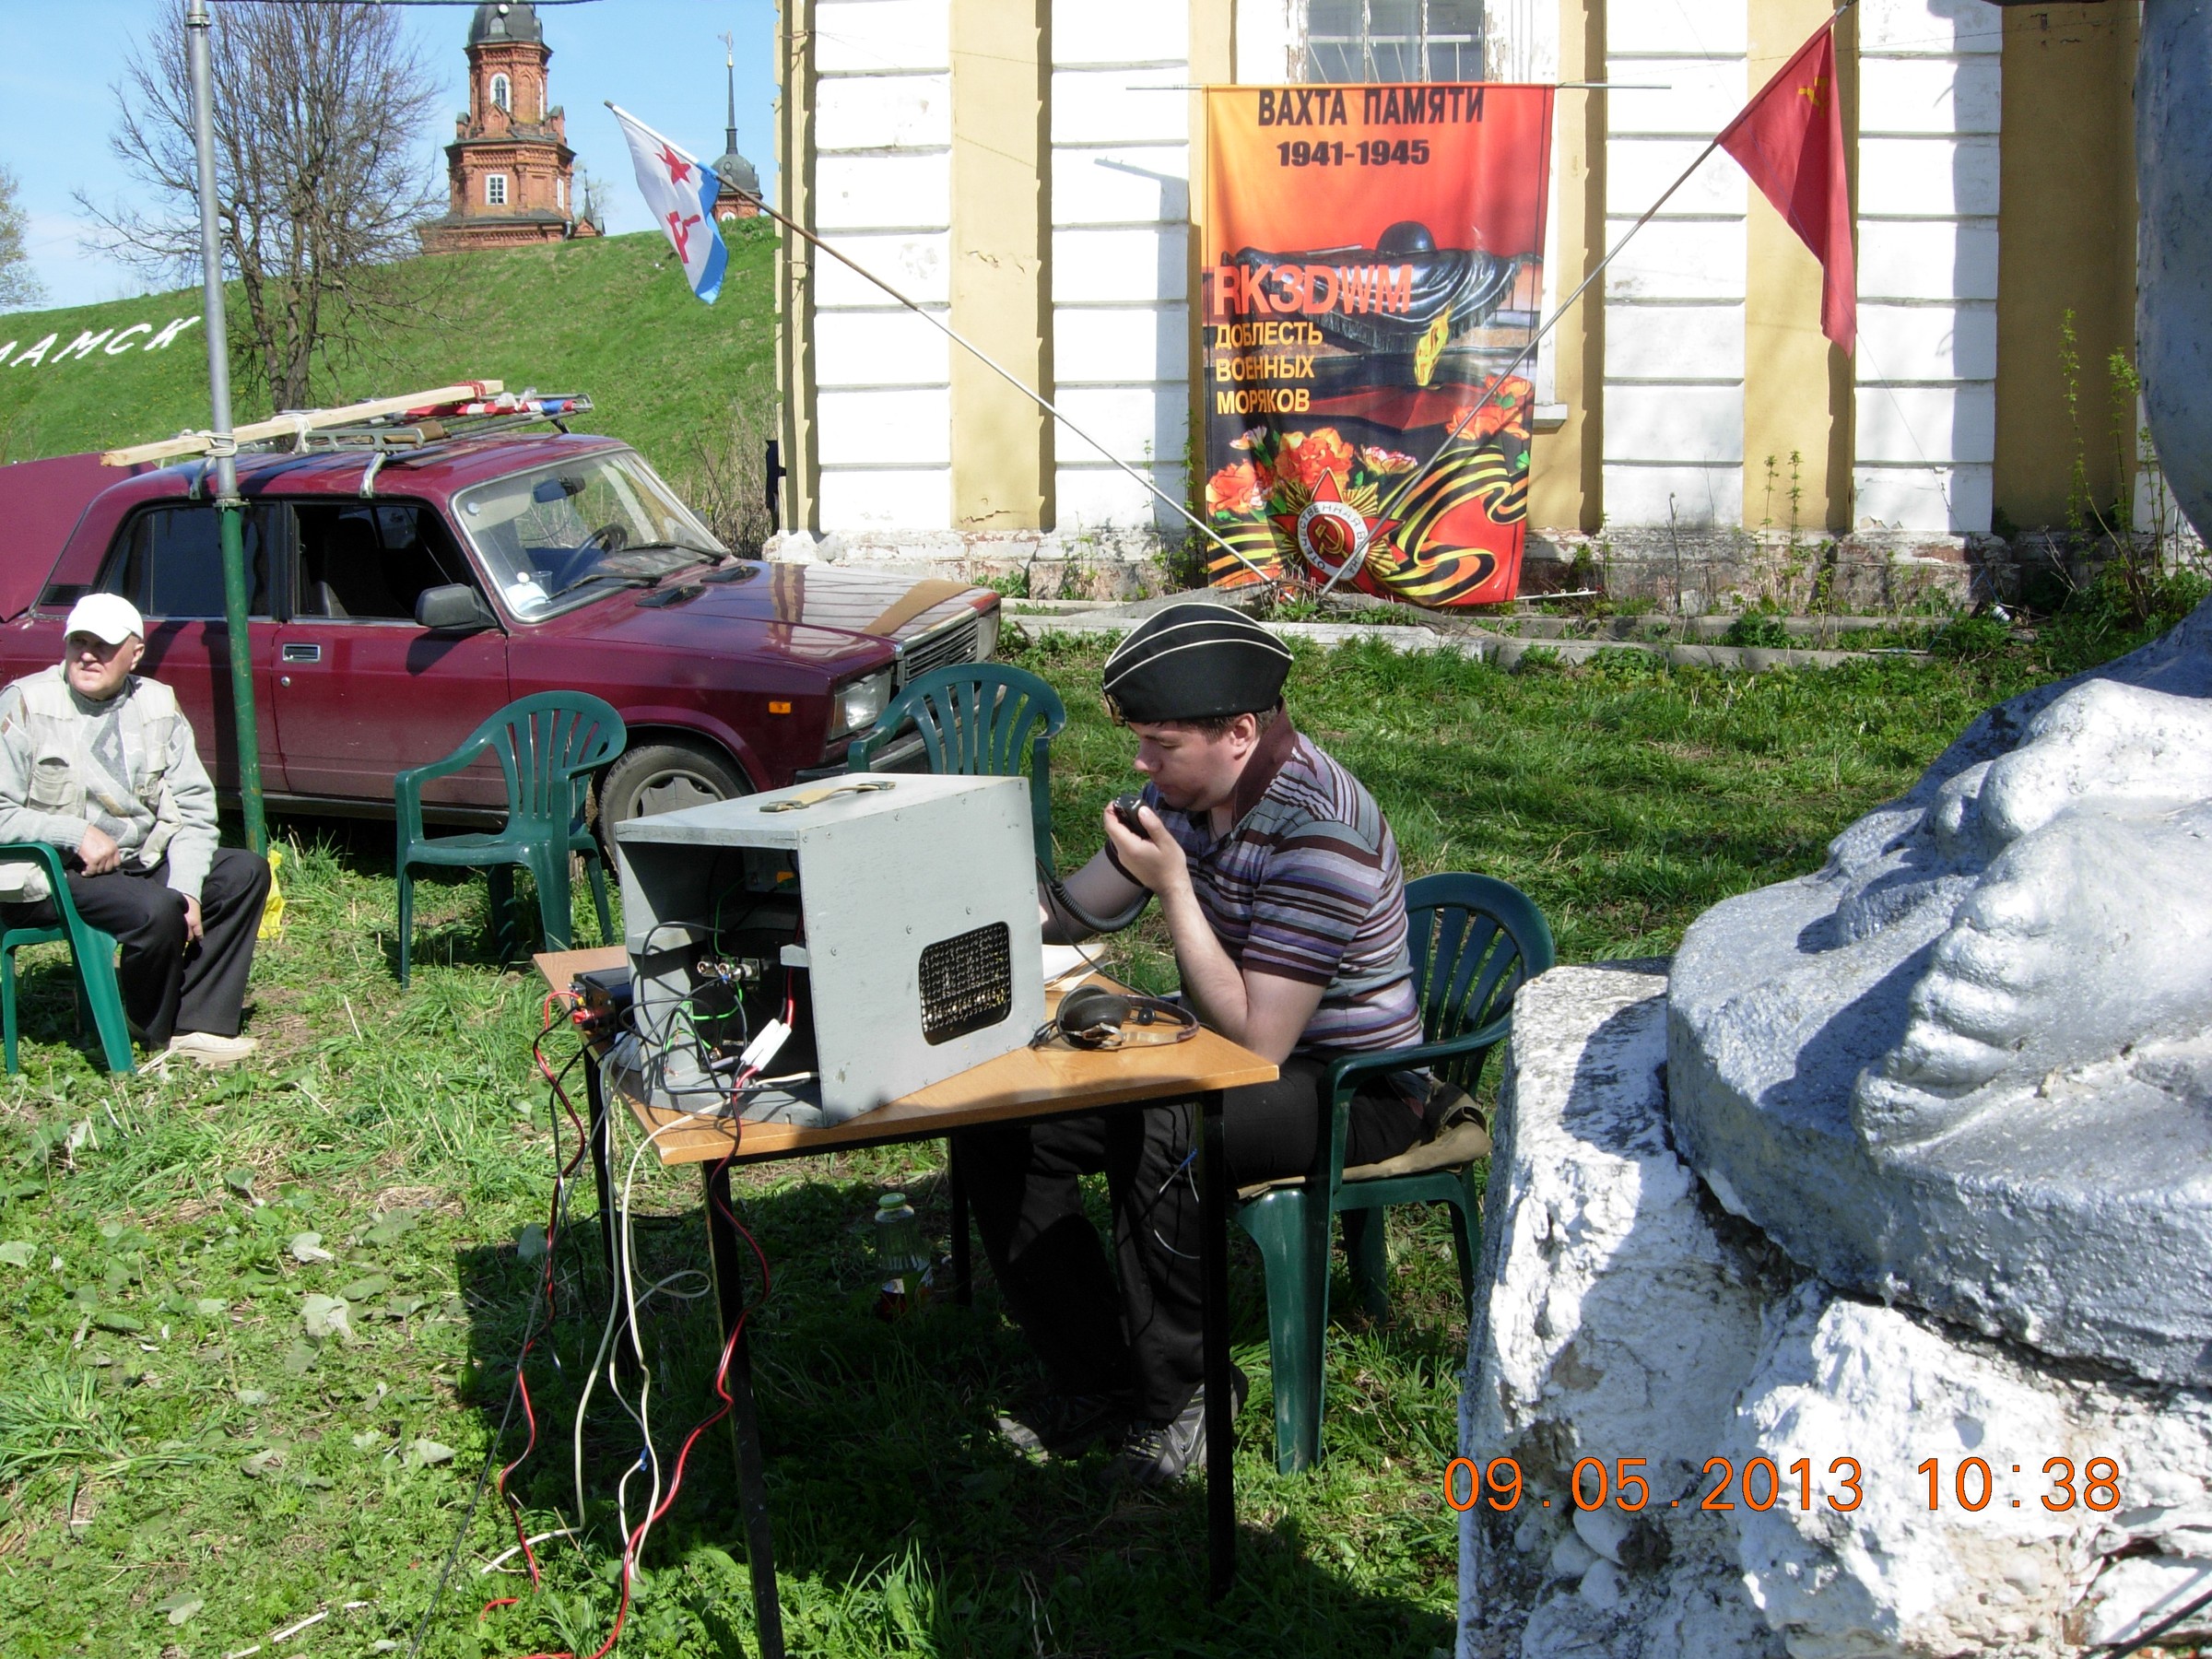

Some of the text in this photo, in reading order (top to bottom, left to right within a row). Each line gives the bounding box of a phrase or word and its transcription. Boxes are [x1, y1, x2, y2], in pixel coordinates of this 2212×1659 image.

[1257, 88, 1485, 126] ВАХТА ПАМЯТИ
[1277, 138, 1431, 168] 1941-1945
[1213, 264, 1414, 316] RK3DWM
[1215, 322, 1324, 349] ДОБЛЕСТЬ
[1216, 355, 1315, 382] ВОЕННЫХ
[1217, 388, 1311, 415] МОРЯКОВ
[1299, 504, 1362, 570] ОТЕЧЕСТВЕННАЯ
